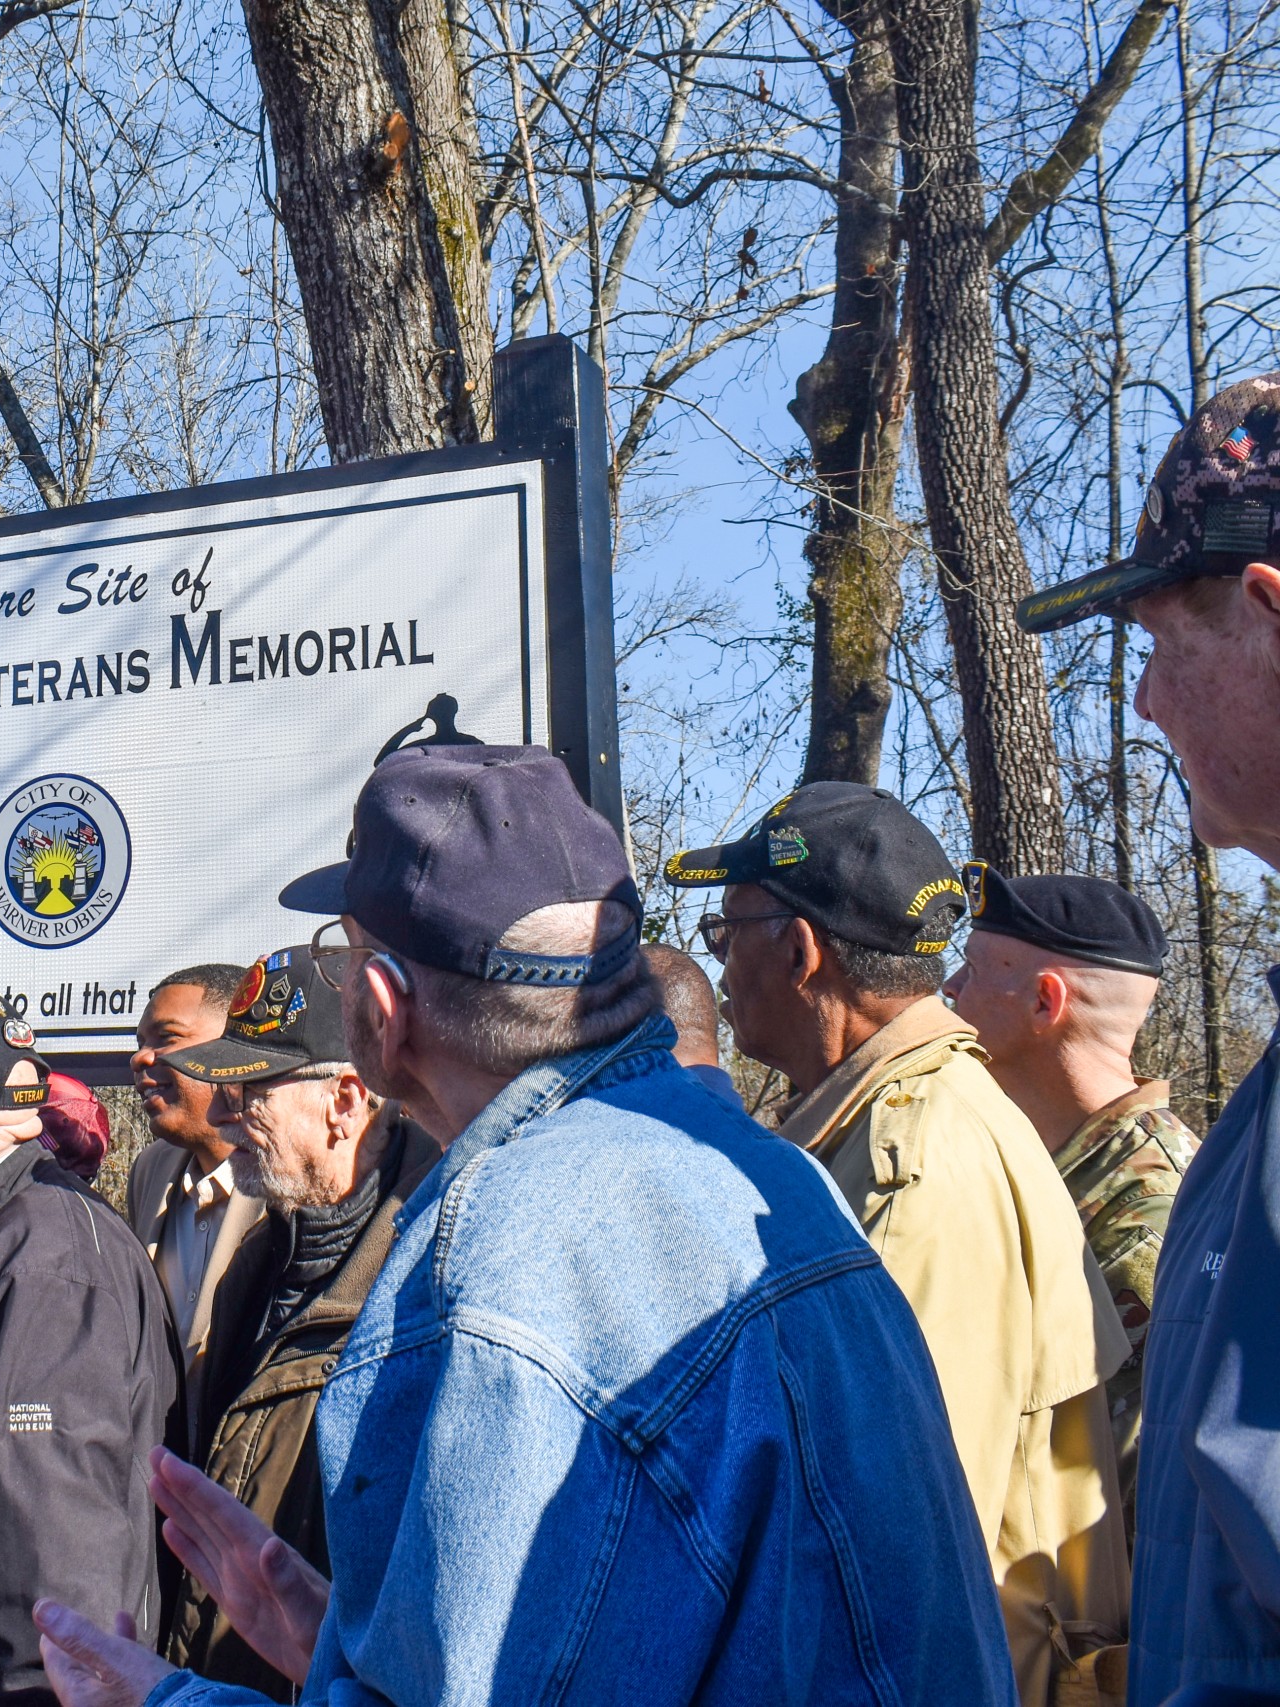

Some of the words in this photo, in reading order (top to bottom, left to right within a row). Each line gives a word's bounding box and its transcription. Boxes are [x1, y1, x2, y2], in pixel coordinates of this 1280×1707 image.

[57, 563, 148, 614] Site
[172, 546, 213, 612] of
[170, 609, 434, 689] MEMORIAL
[14, 782, 65, 814] CITY
[68, 786, 97, 806] OF
[678, 868, 728, 880] SERVED
[53, 888, 113, 939] ROBINS
[41, 983, 72, 1016] all
[83, 981, 137, 1015] that
[185, 1060, 206, 1074] AIR
[210, 1060, 270, 1077] DEFENSE
[13, 1089, 44, 1103] VETERAN
[9, 1404, 50, 1413] NATIONAL
[9, 1413, 52, 1422] CORVETTE
[9, 1422, 52, 1431] MUSEUM
